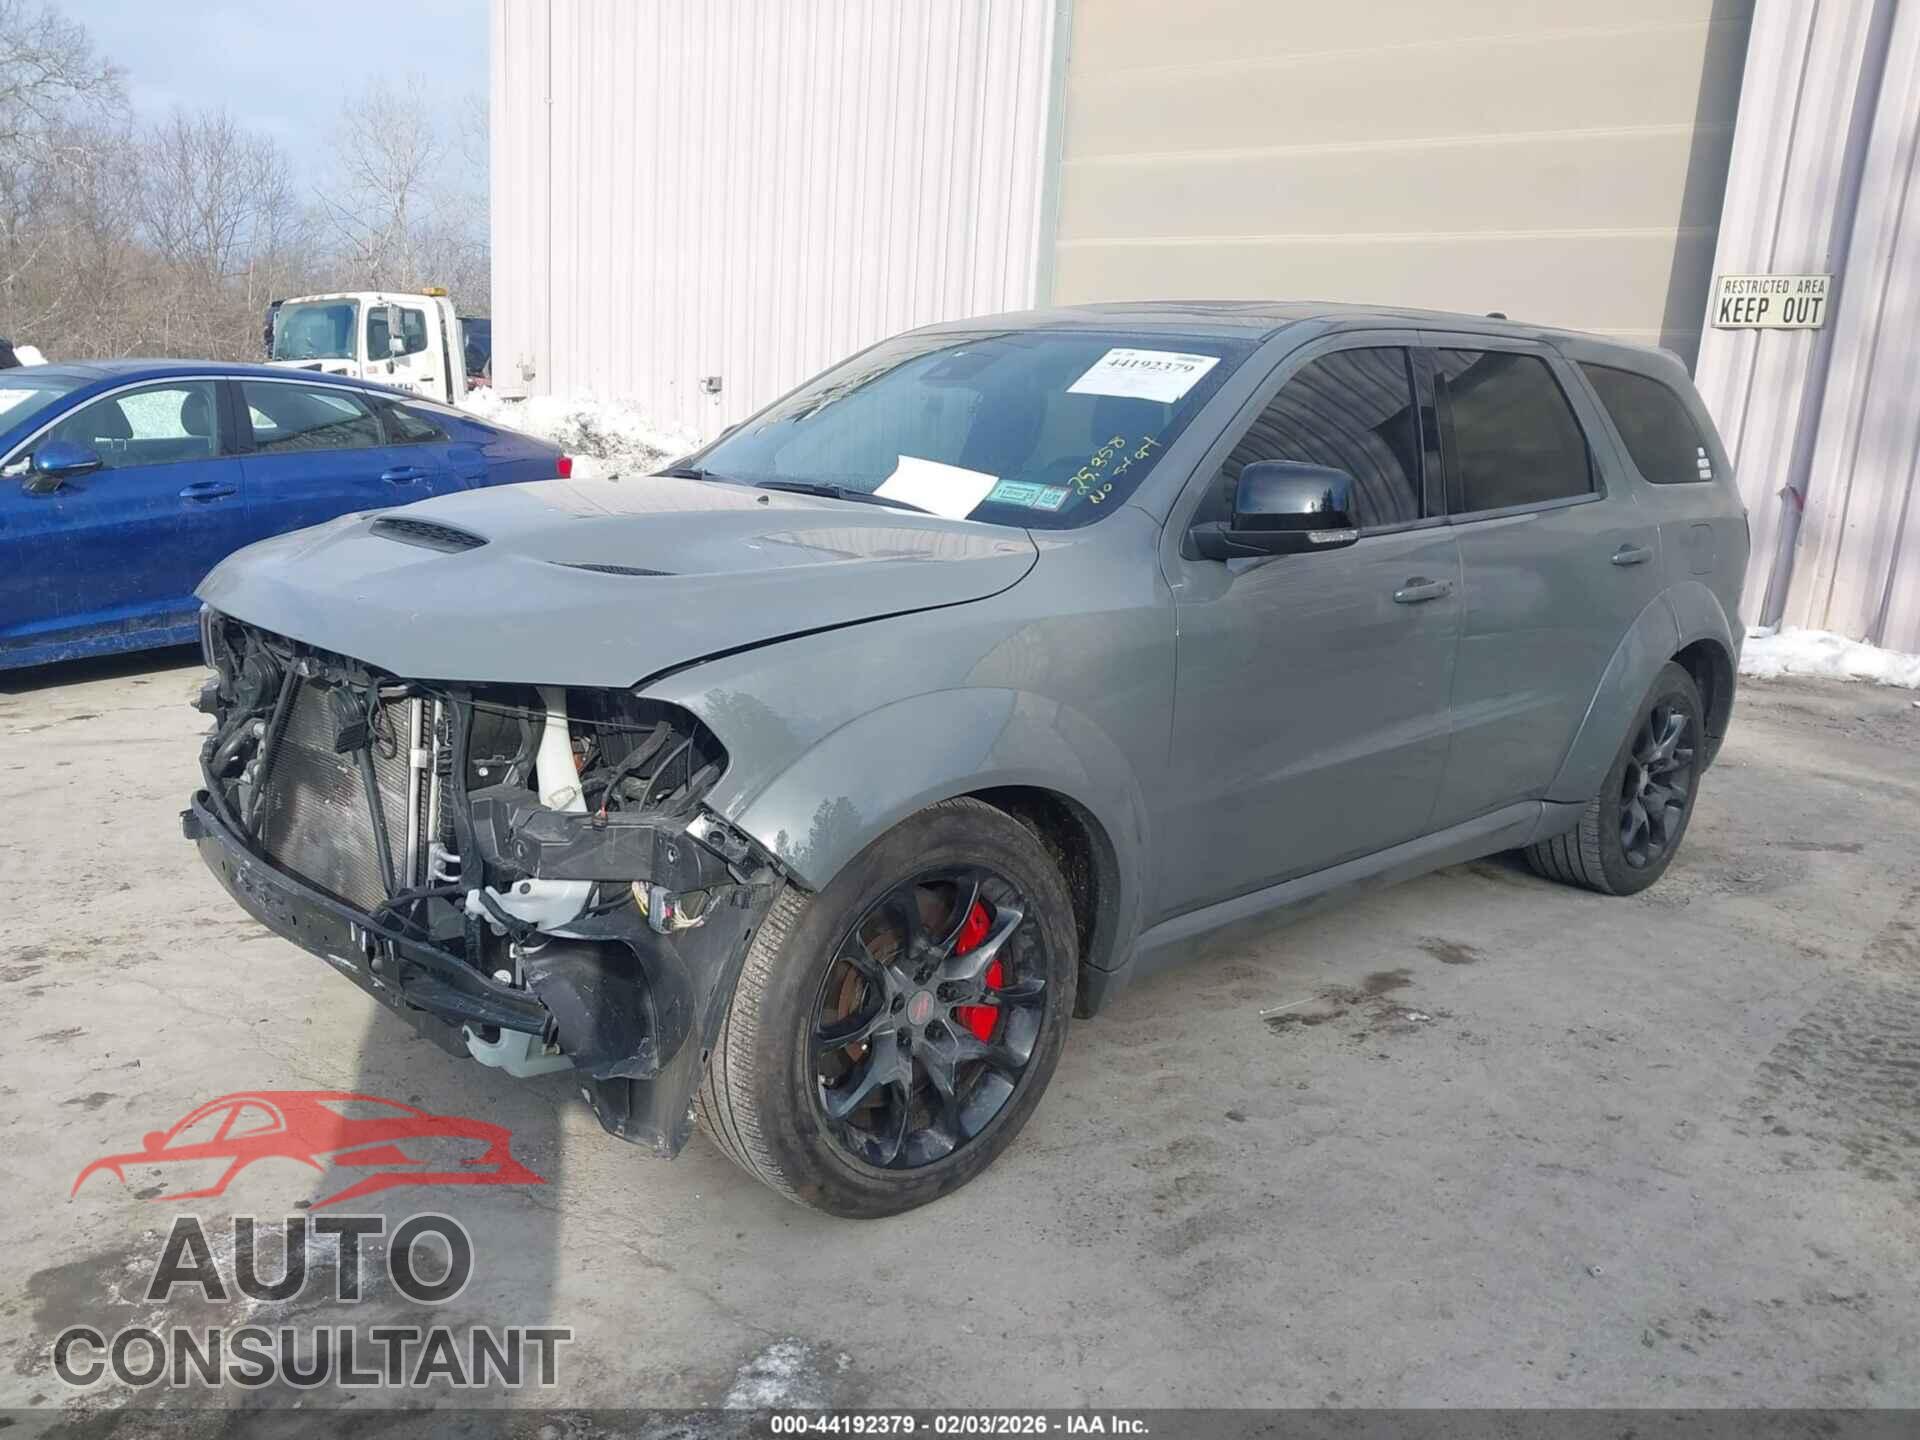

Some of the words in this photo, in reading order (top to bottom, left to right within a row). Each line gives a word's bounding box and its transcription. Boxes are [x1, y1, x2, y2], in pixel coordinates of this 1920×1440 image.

[1724, 279, 1790, 294] RESTRICTED
[1797, 279, 1825, 294] AREA
[1719, 297, 1769, 323] KEEP
[1783, 297, 1823, 323] OUT
[1107, 358, 1196, 374] 44192379
